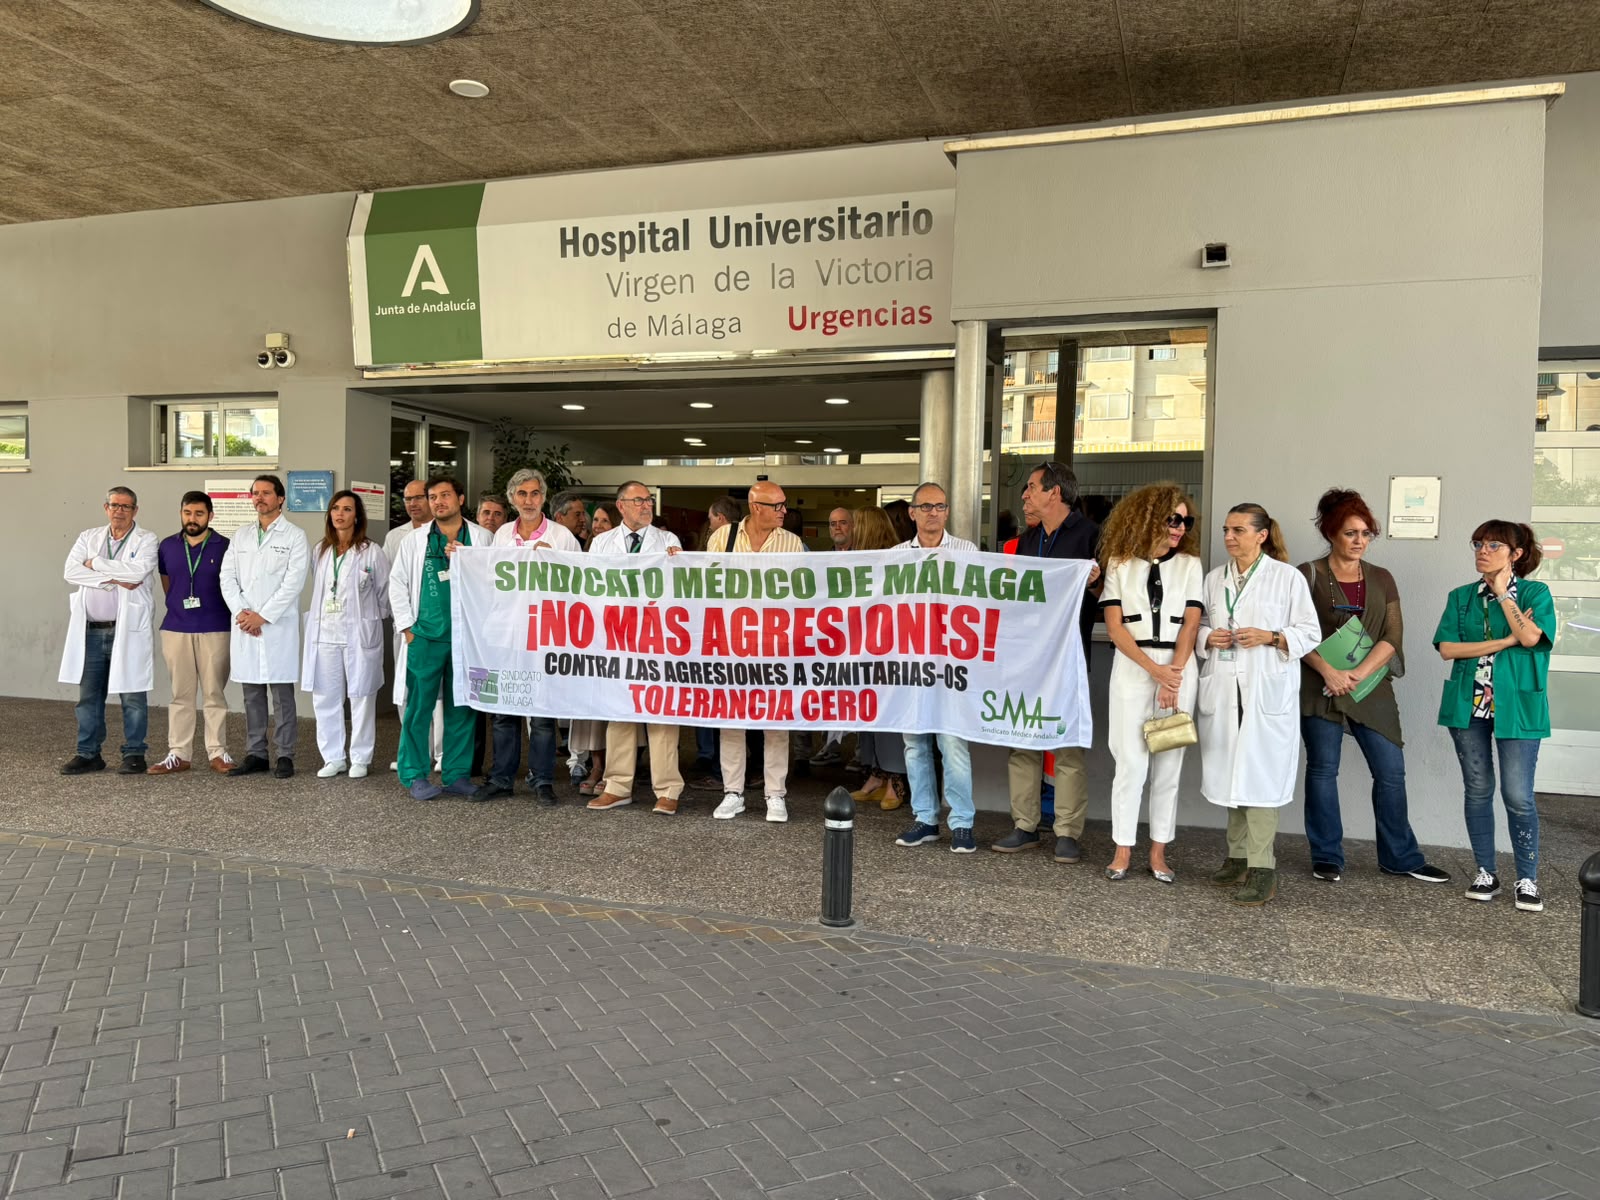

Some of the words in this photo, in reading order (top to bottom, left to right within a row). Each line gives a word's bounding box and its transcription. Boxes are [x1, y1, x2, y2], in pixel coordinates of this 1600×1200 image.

[560, 218, 690, 263] Hospital
[709, 201, 934, 250] Universitario
[605, 268, 695, 303] Virgen
[715, 265, 750, 293] de
[771, 263, 795, 290] la
[815, 253, 934, 287] Victoria
[375, 305, 405, 316] Junta
[407, 303, 420, 314] de
[422, 298, 476, 313] Andalucía
[608, 315, 636, 339] de
[647, 311, 742, 340] Málaga
[787, 300, 933, 336] Urgencias
[495, 562, 664, 599] SINDICATO
[674, 561, 817, 600] MÉDICO
[828, 568, 873, 599] DE
[884, 552, 1046, 603] MÁLAGA
[526, 599, 596, 652] ¡NO
[603, 601, 692, 657] MÁS
[701, 603, 1001, 663] AGRESIONES!
[501, 669, 542, 682] SINDICATO
[501, 681, 532, 694] MÉDICO
[544, 652, 620, 680] CONTRA
[625, 657, 662, 683] LAS
[664, 661, 789, 686] AGRESIONES
[793, 663, 808, 686] A
[811, 661, 969, 692] SANITARIAS-OS
[502, 694, 534, 707] MÁLAGA
[629, 684, 797, 722] TOLERANCIA
[800, 688, 879, 723] CERO
[981, 690, 1061, 729] SMA
[981, 726, 1009, 736] Sindicato
[1011, 729, 1032, 738] Médico
[1033, 732, 1058, 740] Andaluz
